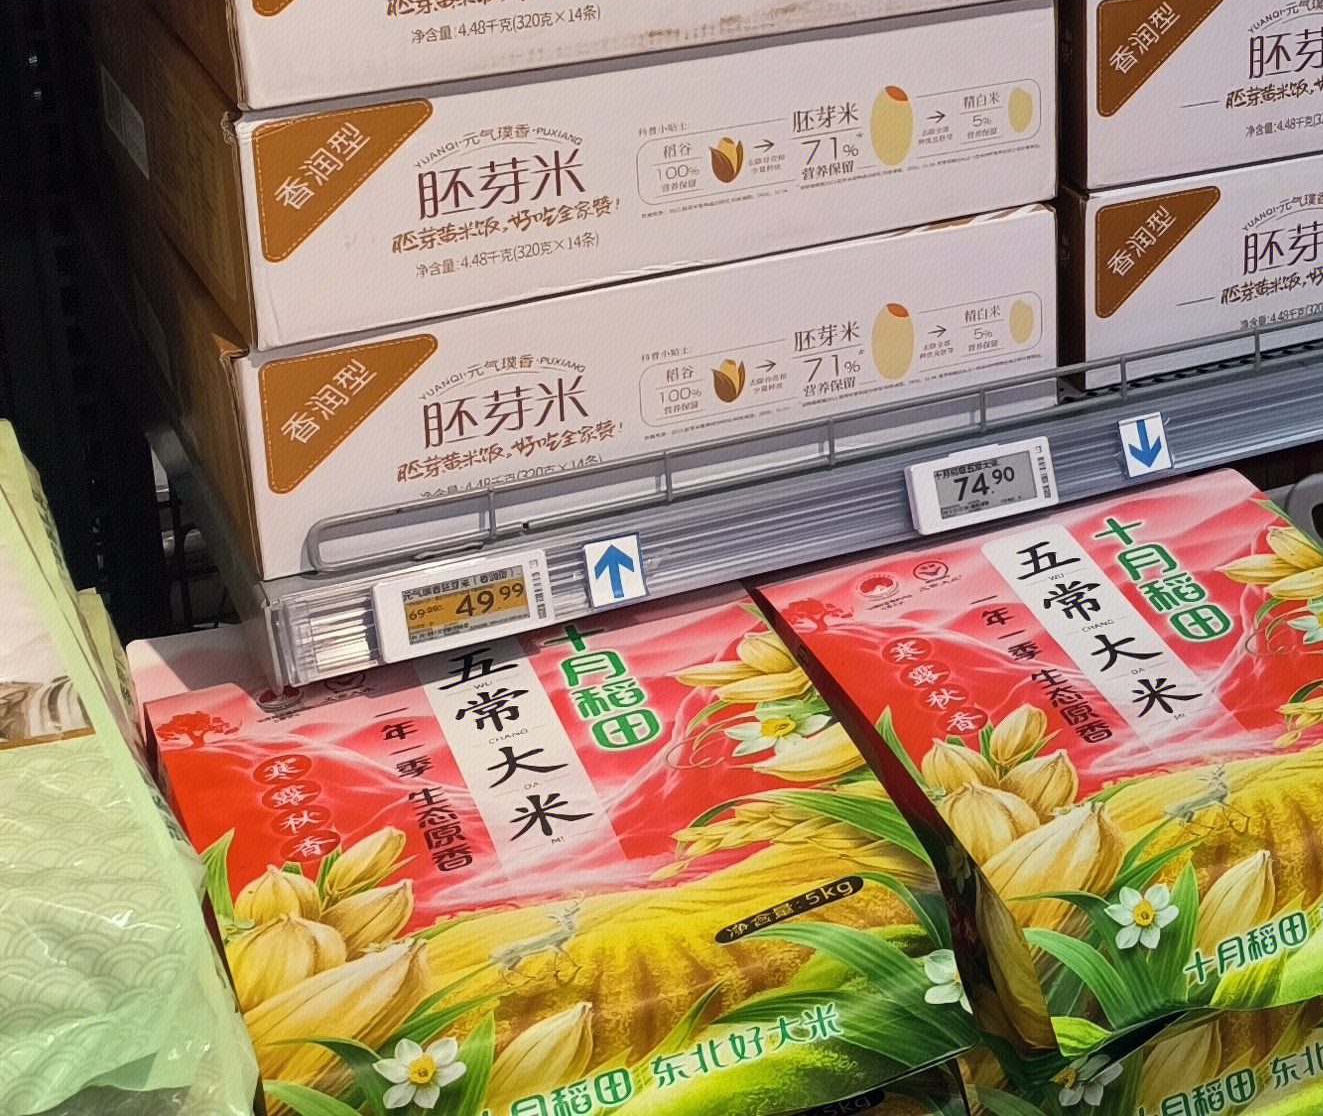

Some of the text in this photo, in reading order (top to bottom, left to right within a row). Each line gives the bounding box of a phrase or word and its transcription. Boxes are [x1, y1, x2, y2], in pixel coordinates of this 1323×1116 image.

[1109, 1, 1182, 76] 香润型
[663, 142, 693, 158] 稻谷
[793, 102, 859, 132] 胚芽米
[274, 122, 371, 212] 香润型
[417, 148, 586, 220] 胚芽米
[658, 164, 699, 181] 100%
[1106, 204, 1178, 278] 香润型
[794, 320, 860, 352] 胚芽米
[281, 358, 377, 445] 香润型
[424, 376, 588, 450] 胚芽米
[659, 387, 702, 403] 100%
[1095, 516, 1232, 642] 十月稻田
[1015, 540, 1204, 718] 五常大米
[538, 625, 661, 751] 十月稻田
[890, 640, 981, 732] 寒露秋香
[970, 596, 1040, 663] 一年一季
[1031, 669, 1113, 744] 生态原香
[438, 642, 596, 842] 五常大米
[263, 755, 335, 861] 寒露秋香
[377, 709, 476, 873] 一年一季 生态原香
[724, 878, 858, 940] 净含量:5kg
[1185, 912, 1309, 982] 十月稻田
[651, 1002, 844, 1090] 东北好大米
